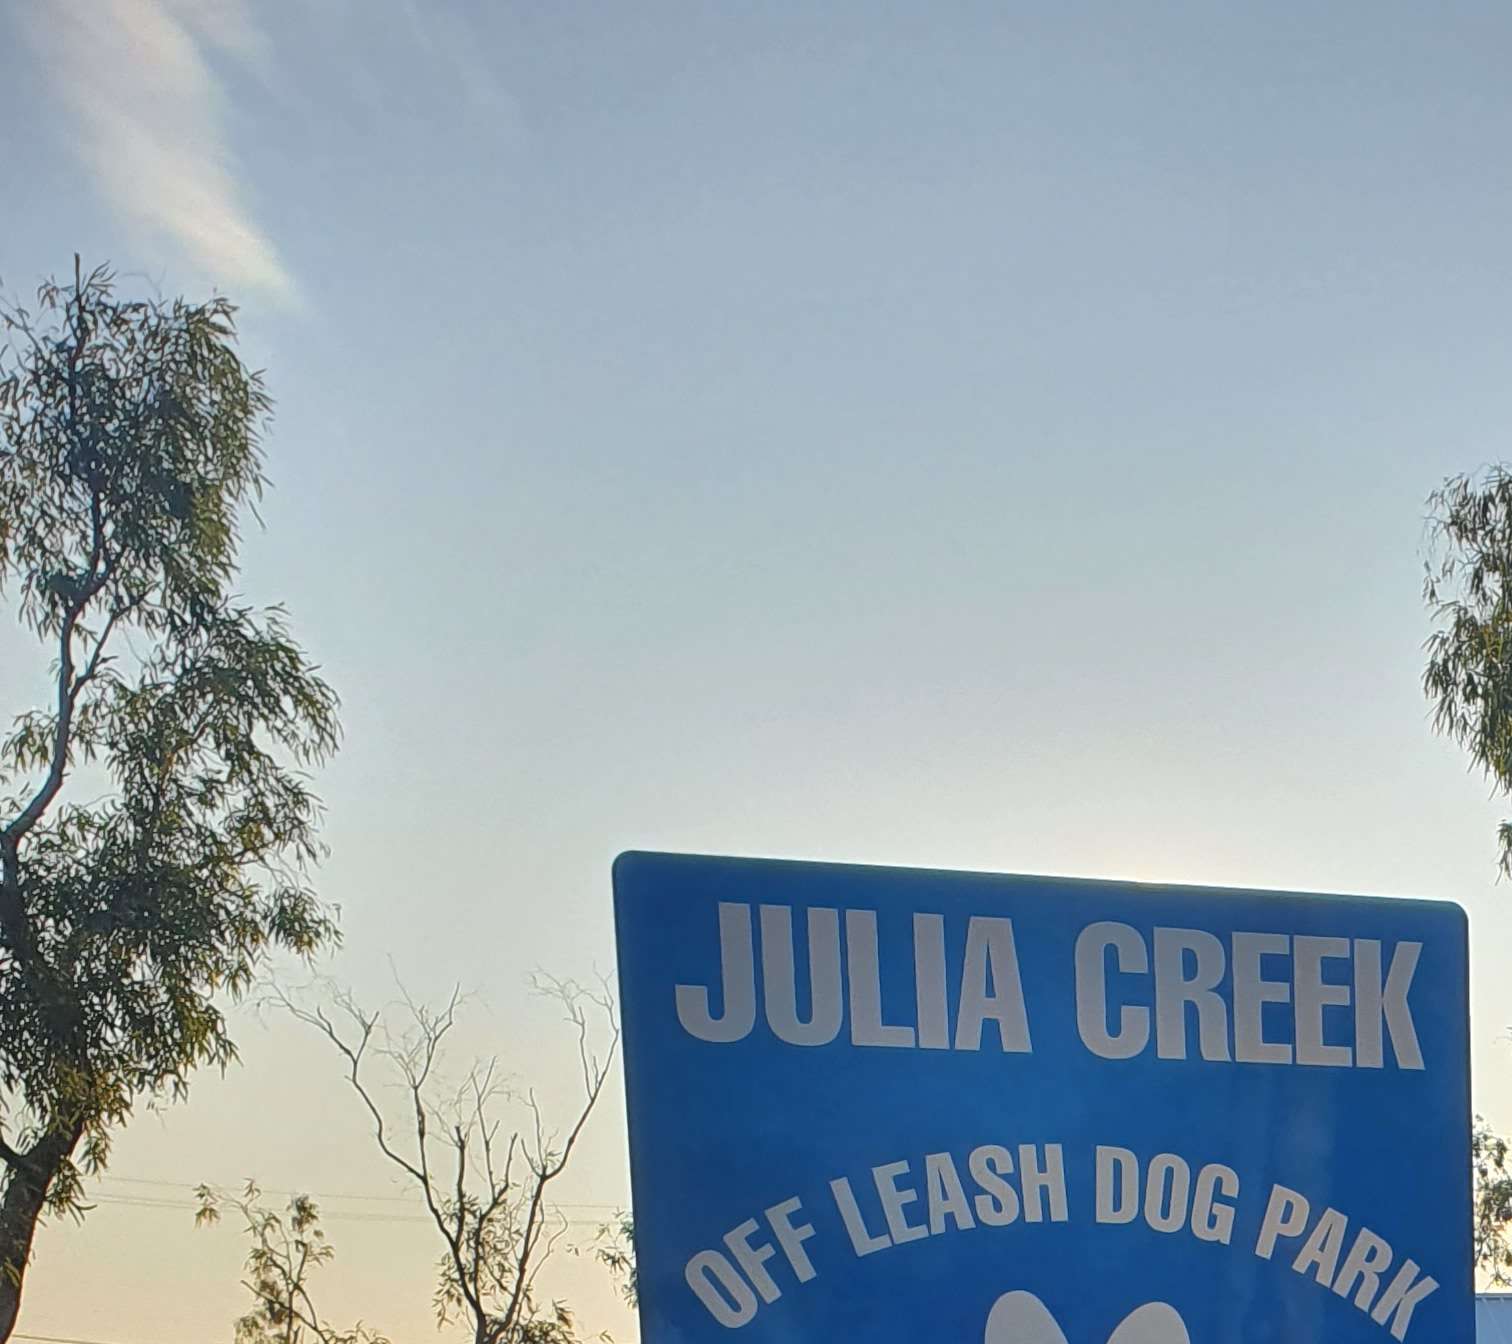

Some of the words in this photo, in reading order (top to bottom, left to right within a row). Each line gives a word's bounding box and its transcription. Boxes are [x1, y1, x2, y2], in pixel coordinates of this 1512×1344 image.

[676, 902, 1032, 1054] JULIA
[1074, 921, 1426, 1071] CREEK
[684, 1196, 817, 1328] OFF
[830, 1142, 1068, 1257] LEASH
[1096, 1145, 1237, 1245] DOG
[1255, 1184, 1439, 1342] PARK
